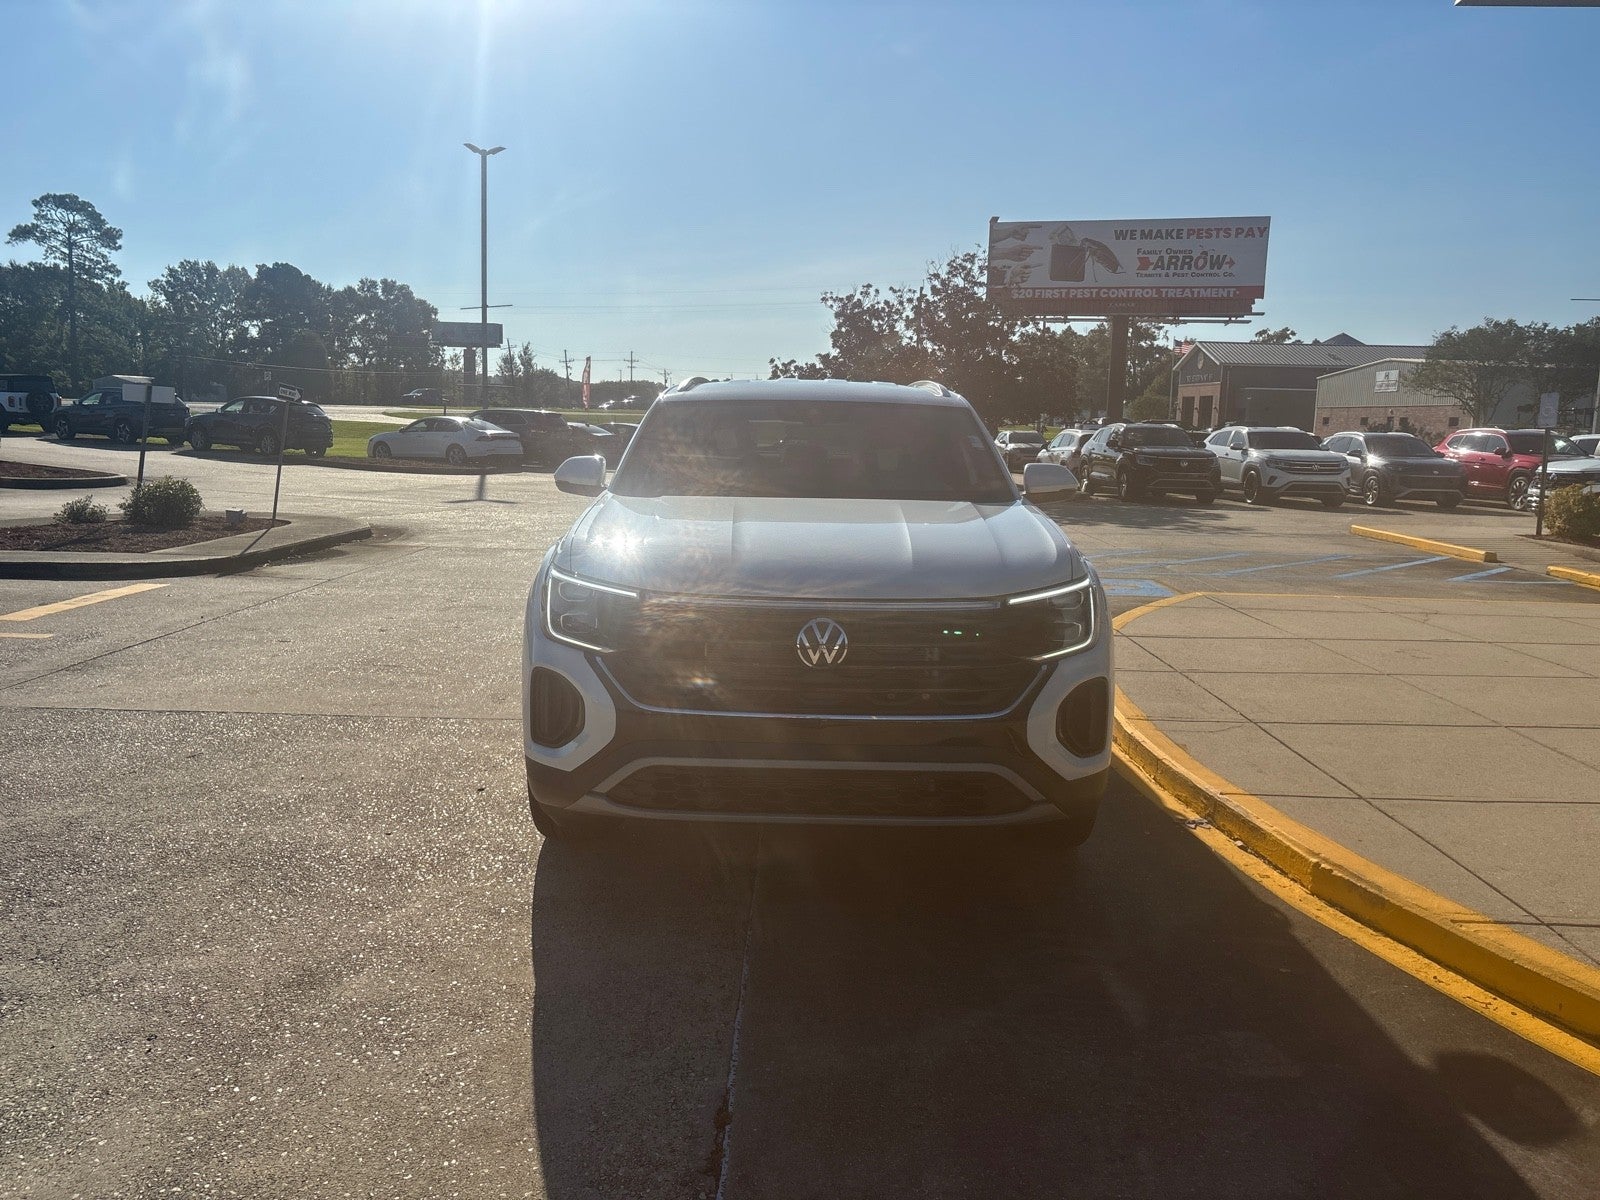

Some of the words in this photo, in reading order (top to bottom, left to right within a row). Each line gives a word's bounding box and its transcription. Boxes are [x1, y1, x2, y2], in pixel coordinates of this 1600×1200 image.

[1114, 229, 1137, 240] WE
[1140, 228, 1184, 240] MAKE
[1186, 227, 1232, 239] PESTS
[1235, 226, 1268, 239] PAY
[1151, 254, 1228, 271] ARROW
[1011, 288, 1033, 299] $20
[1035, 288, 1068, 299] FIRST
[1069, 288, 1098, 298] PEST
[1100, 287, 1158, 298] CONTROL
